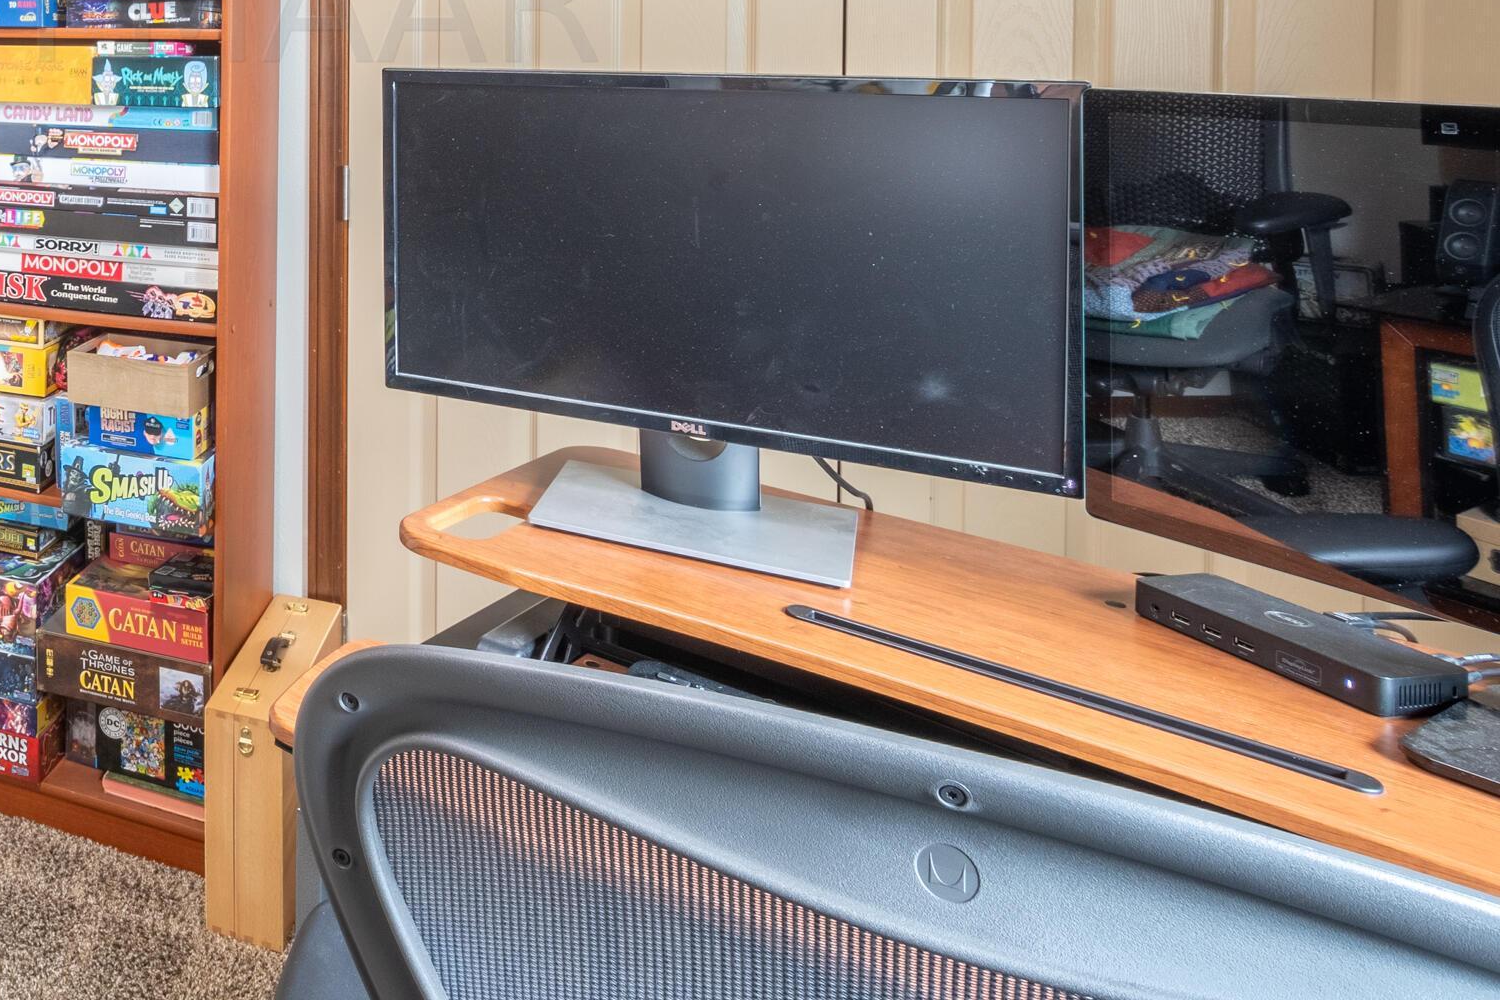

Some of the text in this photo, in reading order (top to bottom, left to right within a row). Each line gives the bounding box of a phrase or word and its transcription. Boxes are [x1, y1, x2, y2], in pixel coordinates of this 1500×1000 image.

[128, 1, 177, 21] CLUE
[3, 105, 94, 122] CANDY LAND
[67, 135, 134, 148] MONOPOLY
[73, 166, 125, 177] MONOPOLY
[6, 209, 41, 225] LIFE
[35, 239, 98, 255] SORRY!
[24, 254, 118, 277] MONOPOLY
[62, 283, 106, 294] The World
[51, 290, 118, 303] Conquest Game
[101, 408, 128, 420] RIGHT
[101, 419, 136, 432] RACIST
[670, 420, 707, 436] DELL
[90, 466, 174, 504] SMASH UP
[104, 504, 114, 514] The
[130, 540, 165, 558] CATAN
[108, 607, 177, 642] CATAN
[182, 624, 203, 633] TRADE
[183, 631, 202, 640] BUILD
[181, 638, 204, 648] SETTLE
[88, 649, 121, 665] GAME
[79, 657, 136, 677] THRONES
[79, 670, 136, 700] CATAN
[106, 718, 120, 728] DC
[173, 729, 190, 739] piece
